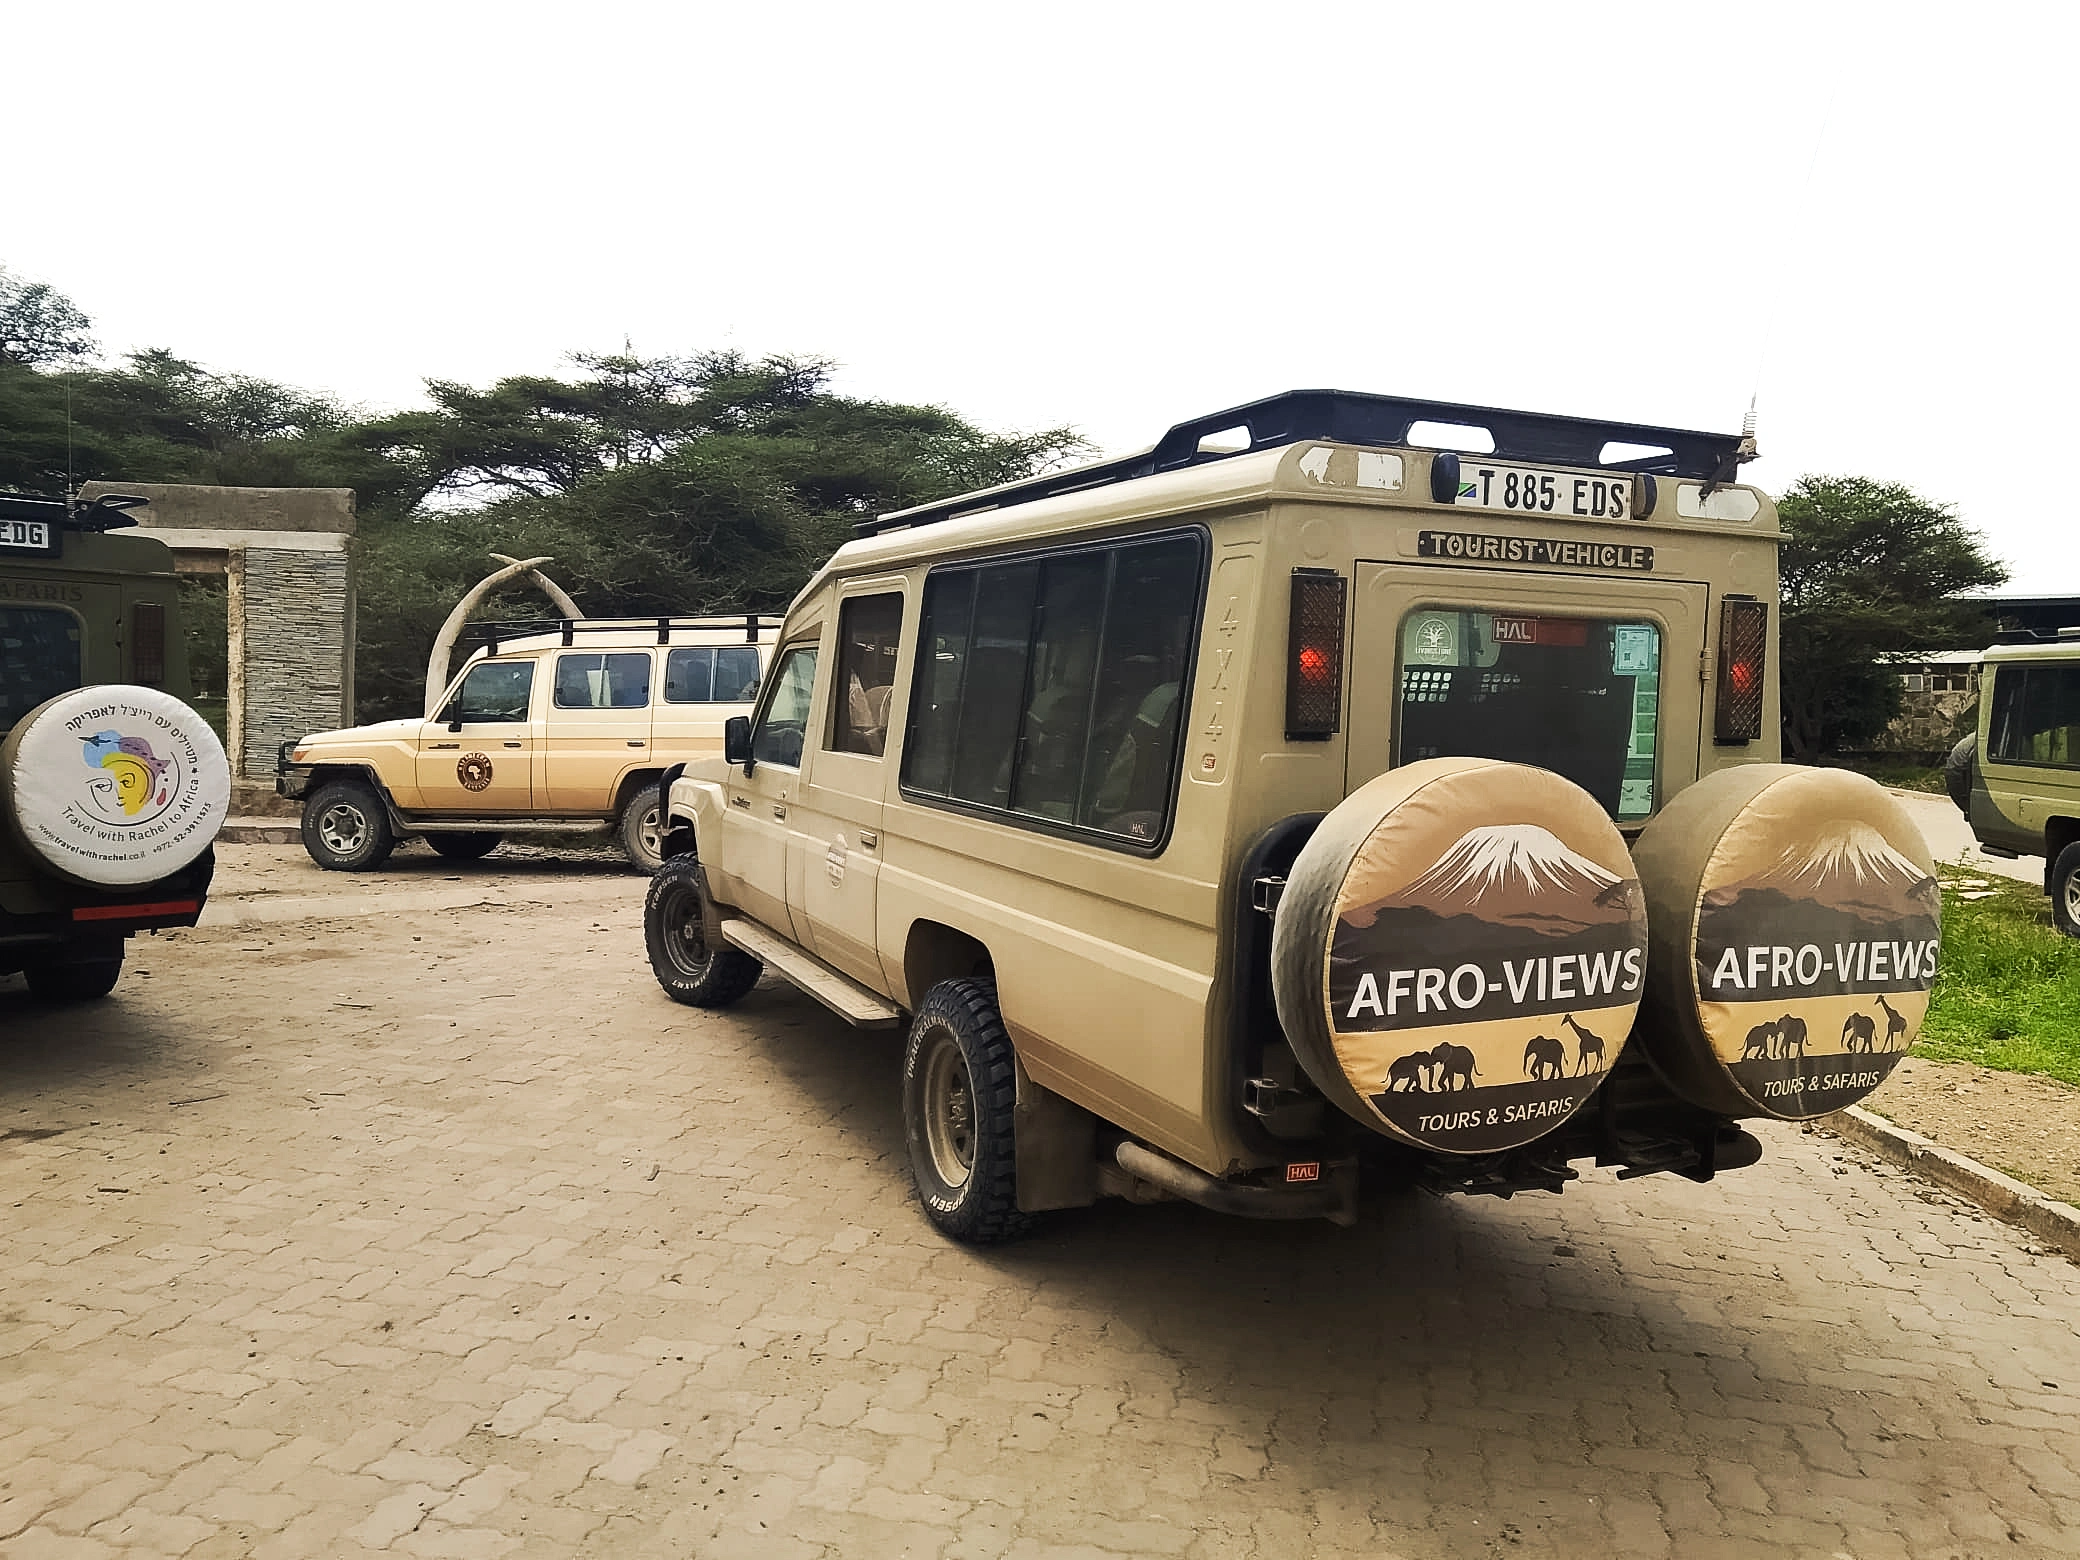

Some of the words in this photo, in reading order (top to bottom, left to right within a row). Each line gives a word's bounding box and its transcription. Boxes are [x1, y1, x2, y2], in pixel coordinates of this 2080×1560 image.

[1479, 468, 1495, 507] T
[1503, 471, 1556, 512] 885
[1573, 479, 1625, 519] EDS
[1430, 533, 1540, 562] TOURIST
[1545, 542, 1645, 569] VEHICLE
[1496, 621, 1532, 641] HAL
[65, 704, 116, 732] לאפריקה
[154, 715, 172, 729] עם
[171, 728, 198, 764] מטיילים
[61, 805, 96, 835] Travel
[97, 830, 125, 842] with
[128, 821, 169, 842] Rachel
[168, 813, 182, 824] to
[178, 779, 199, 813] Africa
[1712, 938, 1939, 990] AFRO-VIEWS
[1346, 947, 1643, 1019] AFRO-VIEWS
[1763, 1076, 1805, 1098] TOURS
[1808, 1075, 1819, 1091] &
[1822, 1071, 1880, 1091] SAFARIS
[1418, 1109, 1481, 1132] TOURS
[1485, 1107, 1499, 1126] &
[1503, 1096, 1573, 1124] SAFARIS
